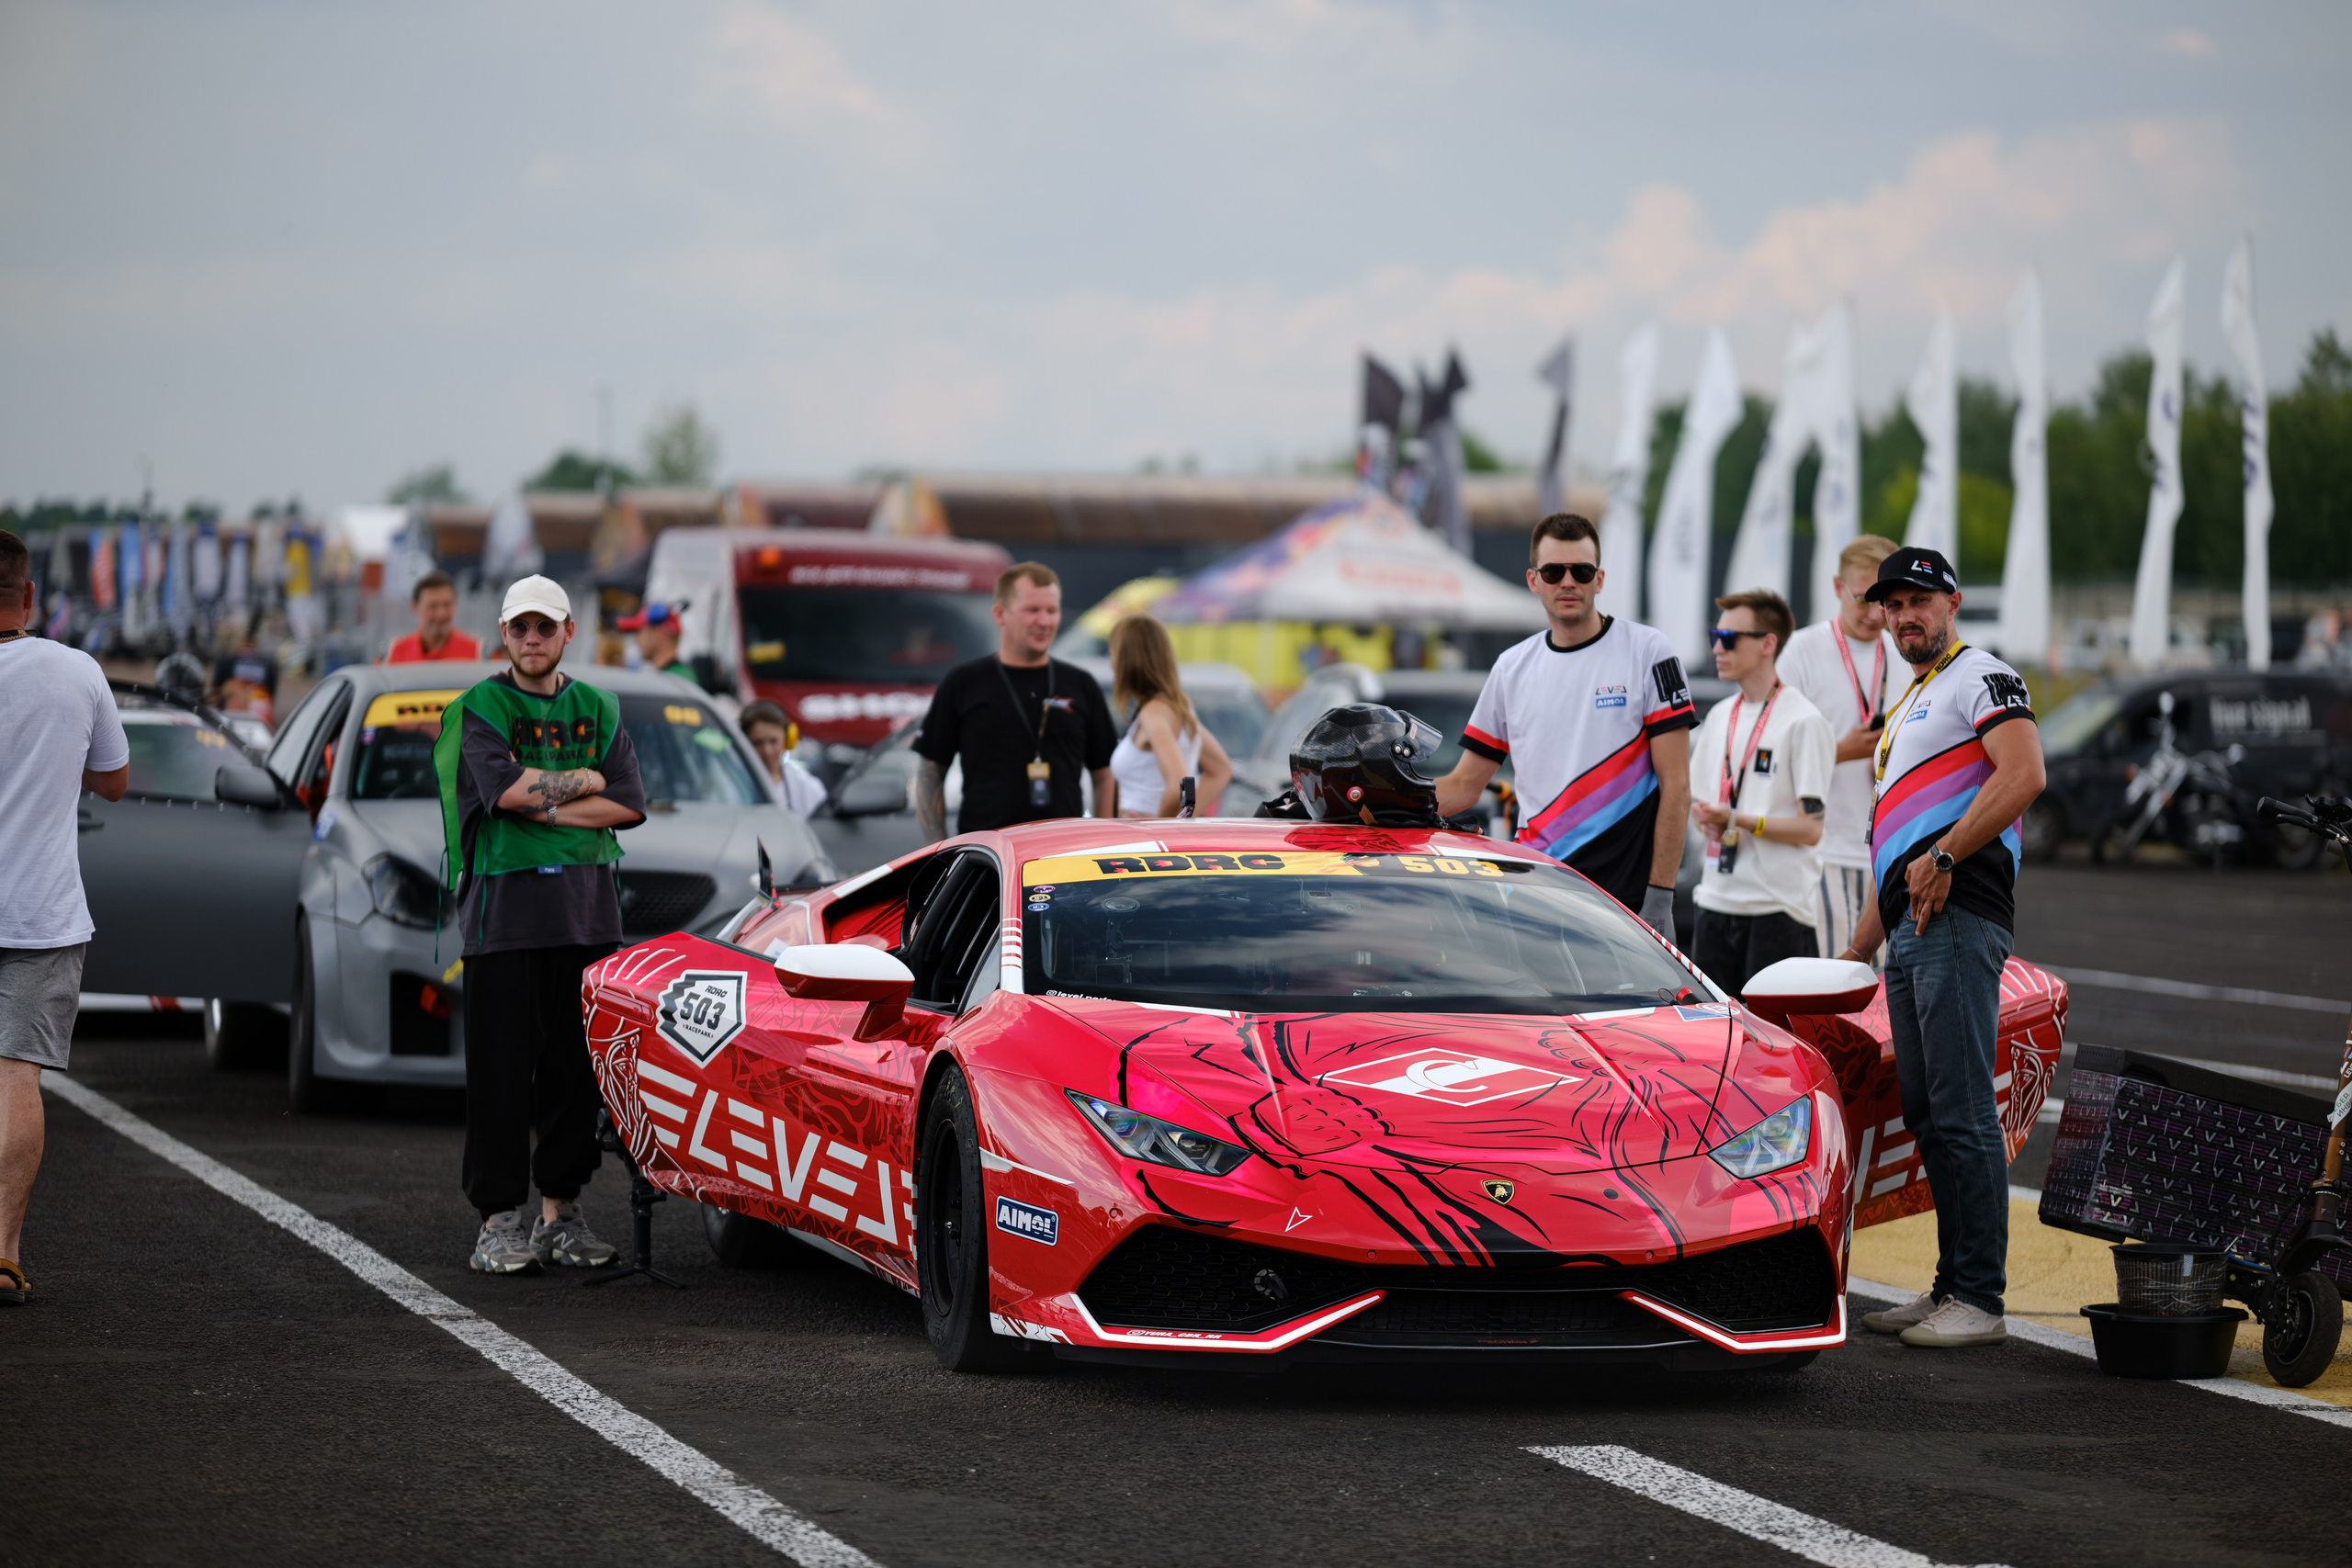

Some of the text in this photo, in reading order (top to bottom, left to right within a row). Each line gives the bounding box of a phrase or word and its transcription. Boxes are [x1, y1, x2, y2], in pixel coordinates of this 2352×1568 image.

[1934, 653, 1951, 672] RDRC
[1597, 698, 1625, 706] AIMOL
[1091, 854, 1504, 877] RDRC 503
[705, 985, 728, 998] RDRC
[680, 991, 726, 1031] 503
[684, 1023, 711, 1038] RACEPARK
[998, 1204, 1055, 1239] AIMOL
